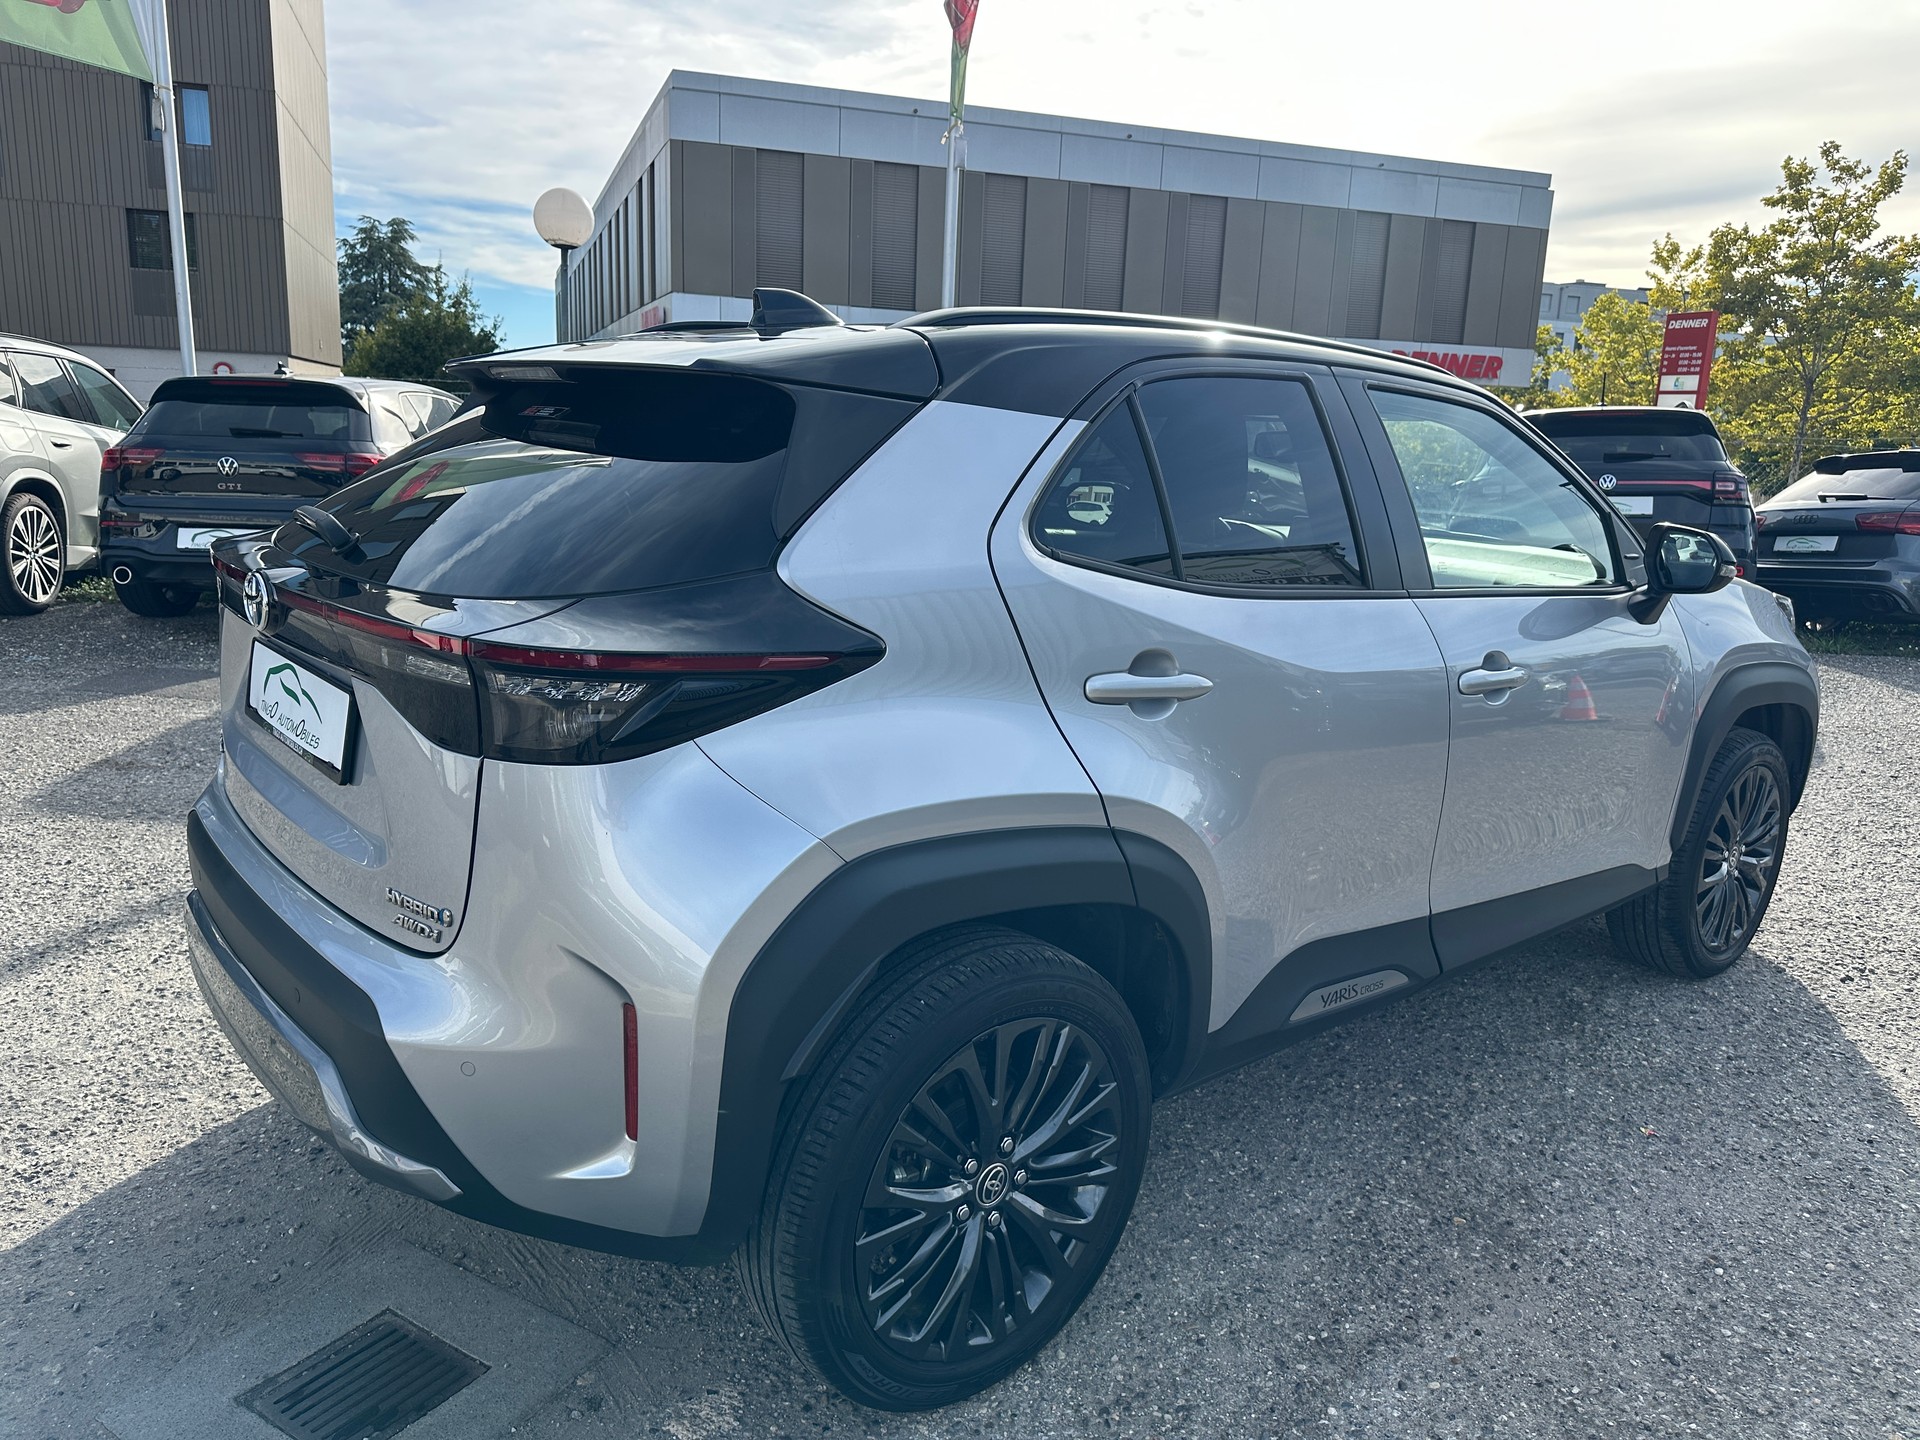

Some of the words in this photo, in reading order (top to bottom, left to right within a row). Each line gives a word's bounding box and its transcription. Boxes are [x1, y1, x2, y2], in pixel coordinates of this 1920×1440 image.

[1668, 318, 1709, 329] DENNER
[1391, 350, 1503, 379] NNER
[217, 482, 242, 490] GTI
[276, 713, 321, 750] AUTOMOBILES
[385, 887, 440, 924] HYBRID
[1360, 979, 1384, 996] CROSS
